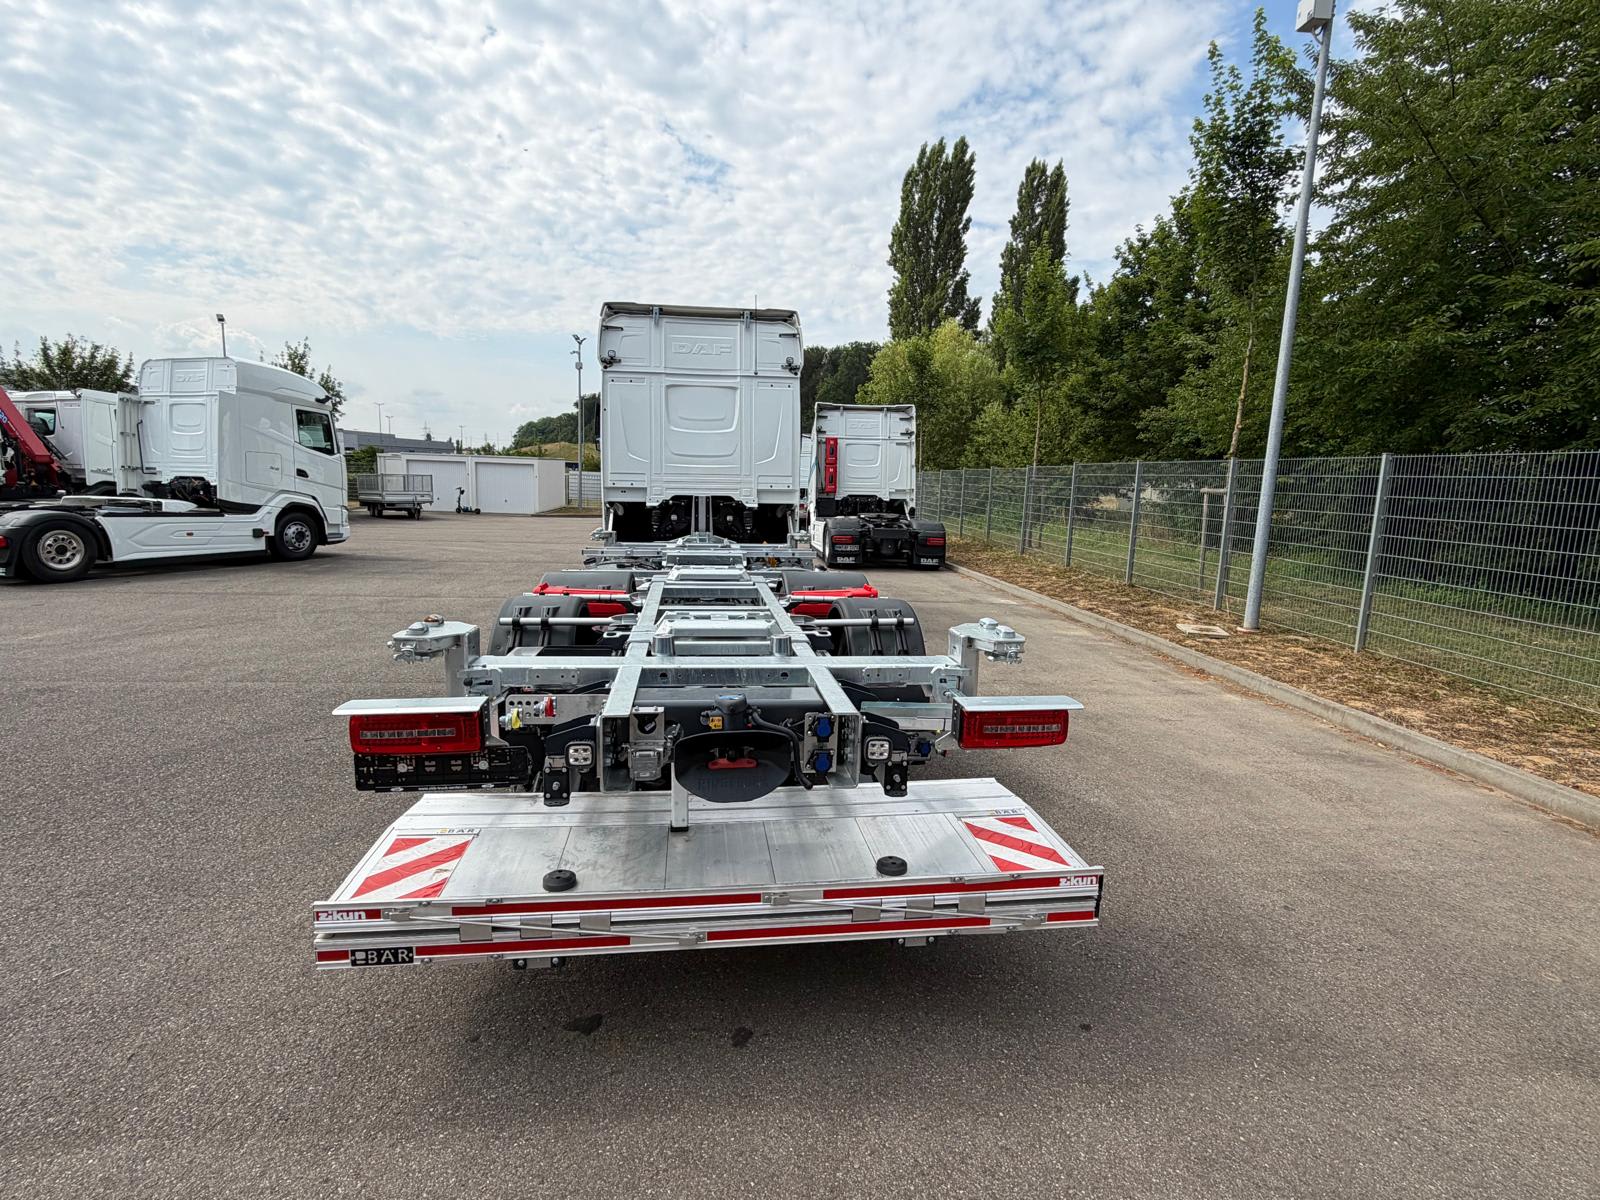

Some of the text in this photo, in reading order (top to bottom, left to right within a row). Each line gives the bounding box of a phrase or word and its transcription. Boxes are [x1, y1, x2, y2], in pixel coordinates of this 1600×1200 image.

[672, 342, 732, 355] DAF
[1059, 875, 1097, 886] zikun
[318, 910, 367, 921] zikun
[367, 949, 410, 964] BÄR
